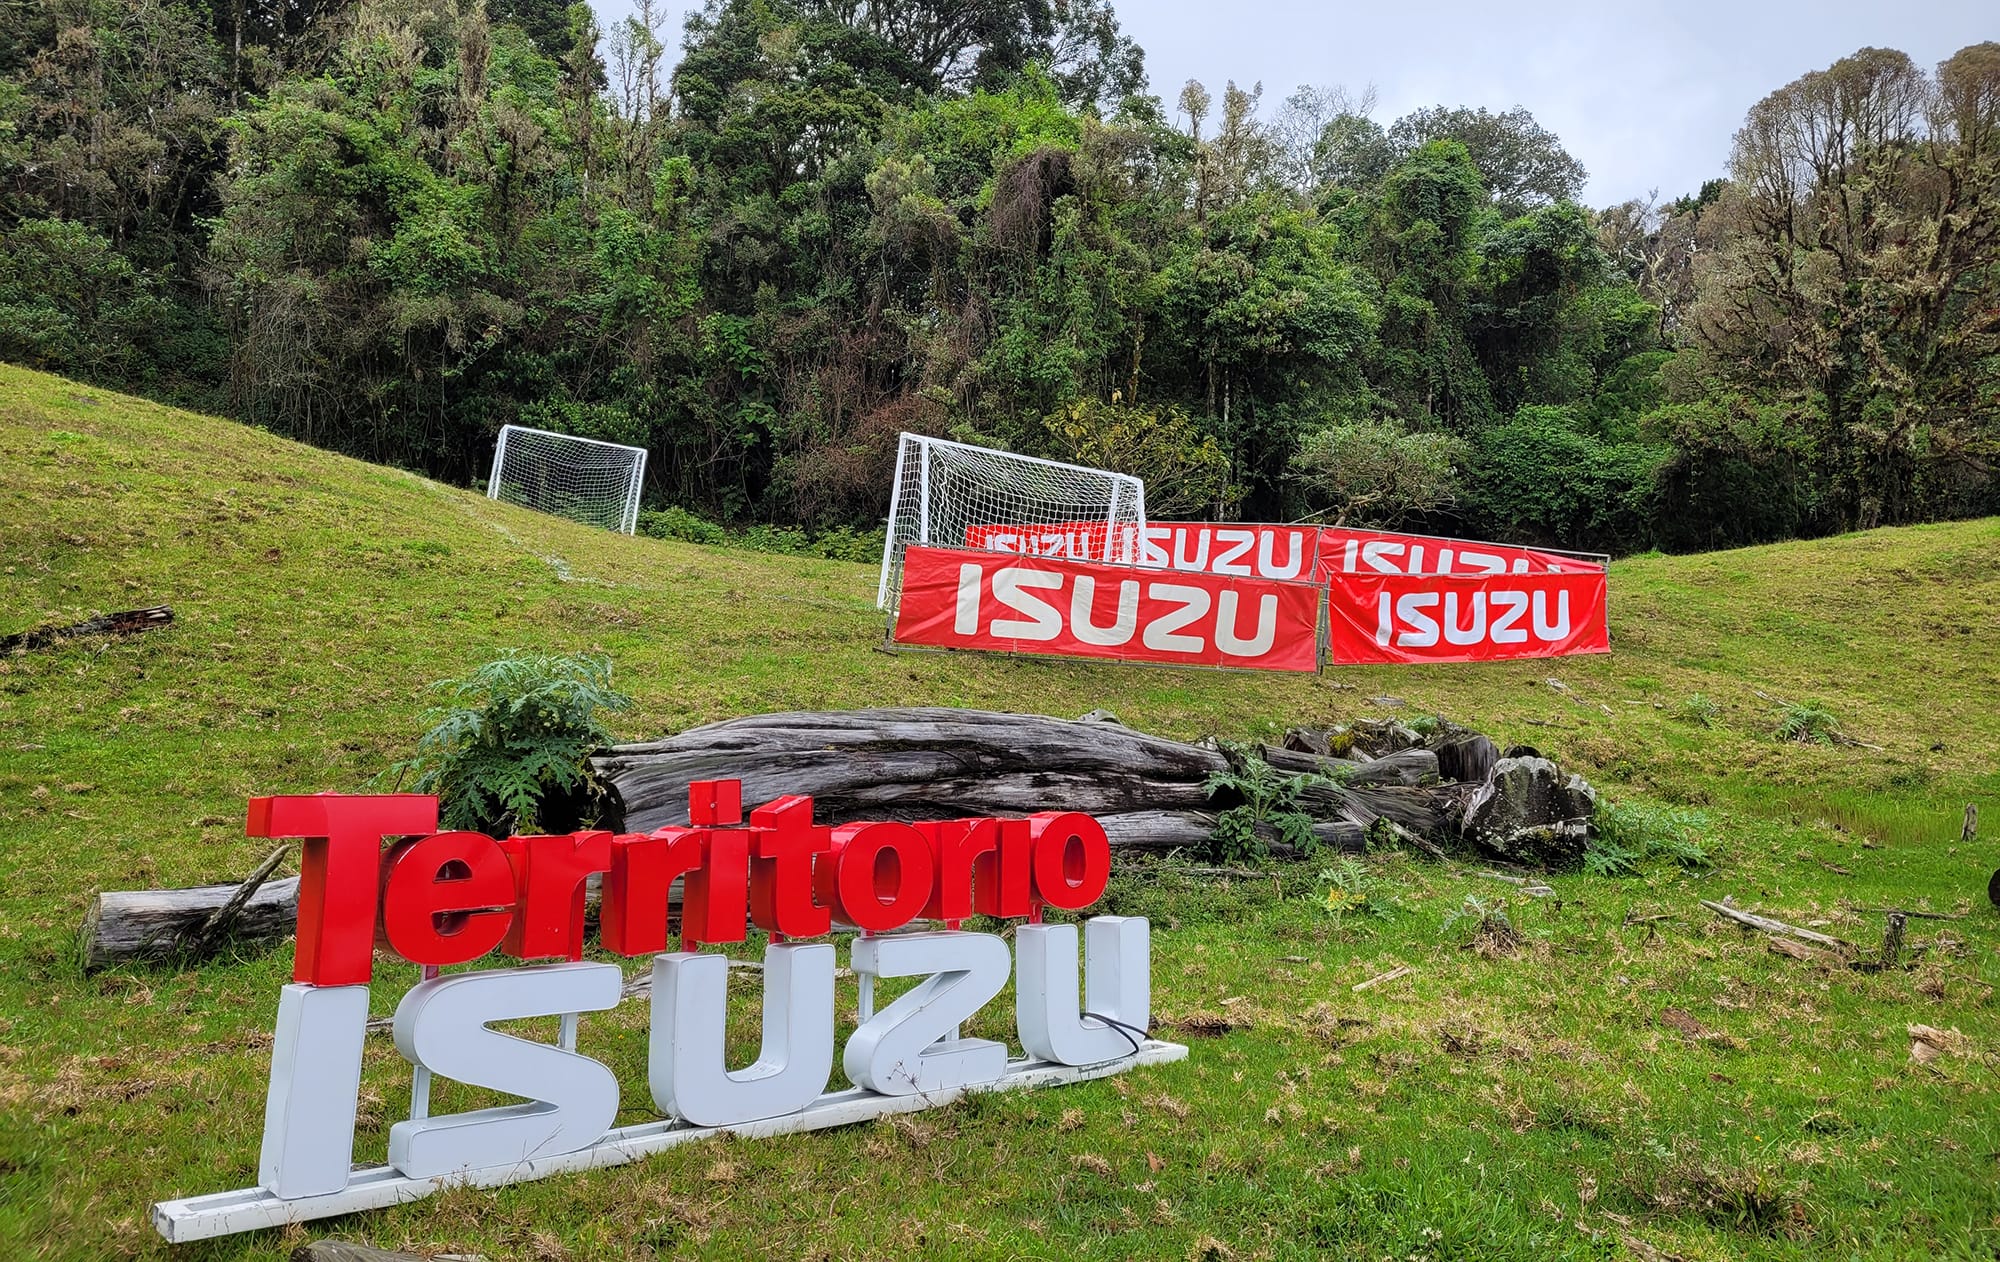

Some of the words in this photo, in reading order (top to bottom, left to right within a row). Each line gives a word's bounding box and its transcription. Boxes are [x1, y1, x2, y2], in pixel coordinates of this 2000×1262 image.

[1121, 527, 1302, 580] ISUZU
[954, 563, 1278, 657] ISUZU
[1376, 590, 1570, 647] ISUZU
[247, 780, 1110, 986] Territorio
[259, 916, 1150, 1199] ISUZU
